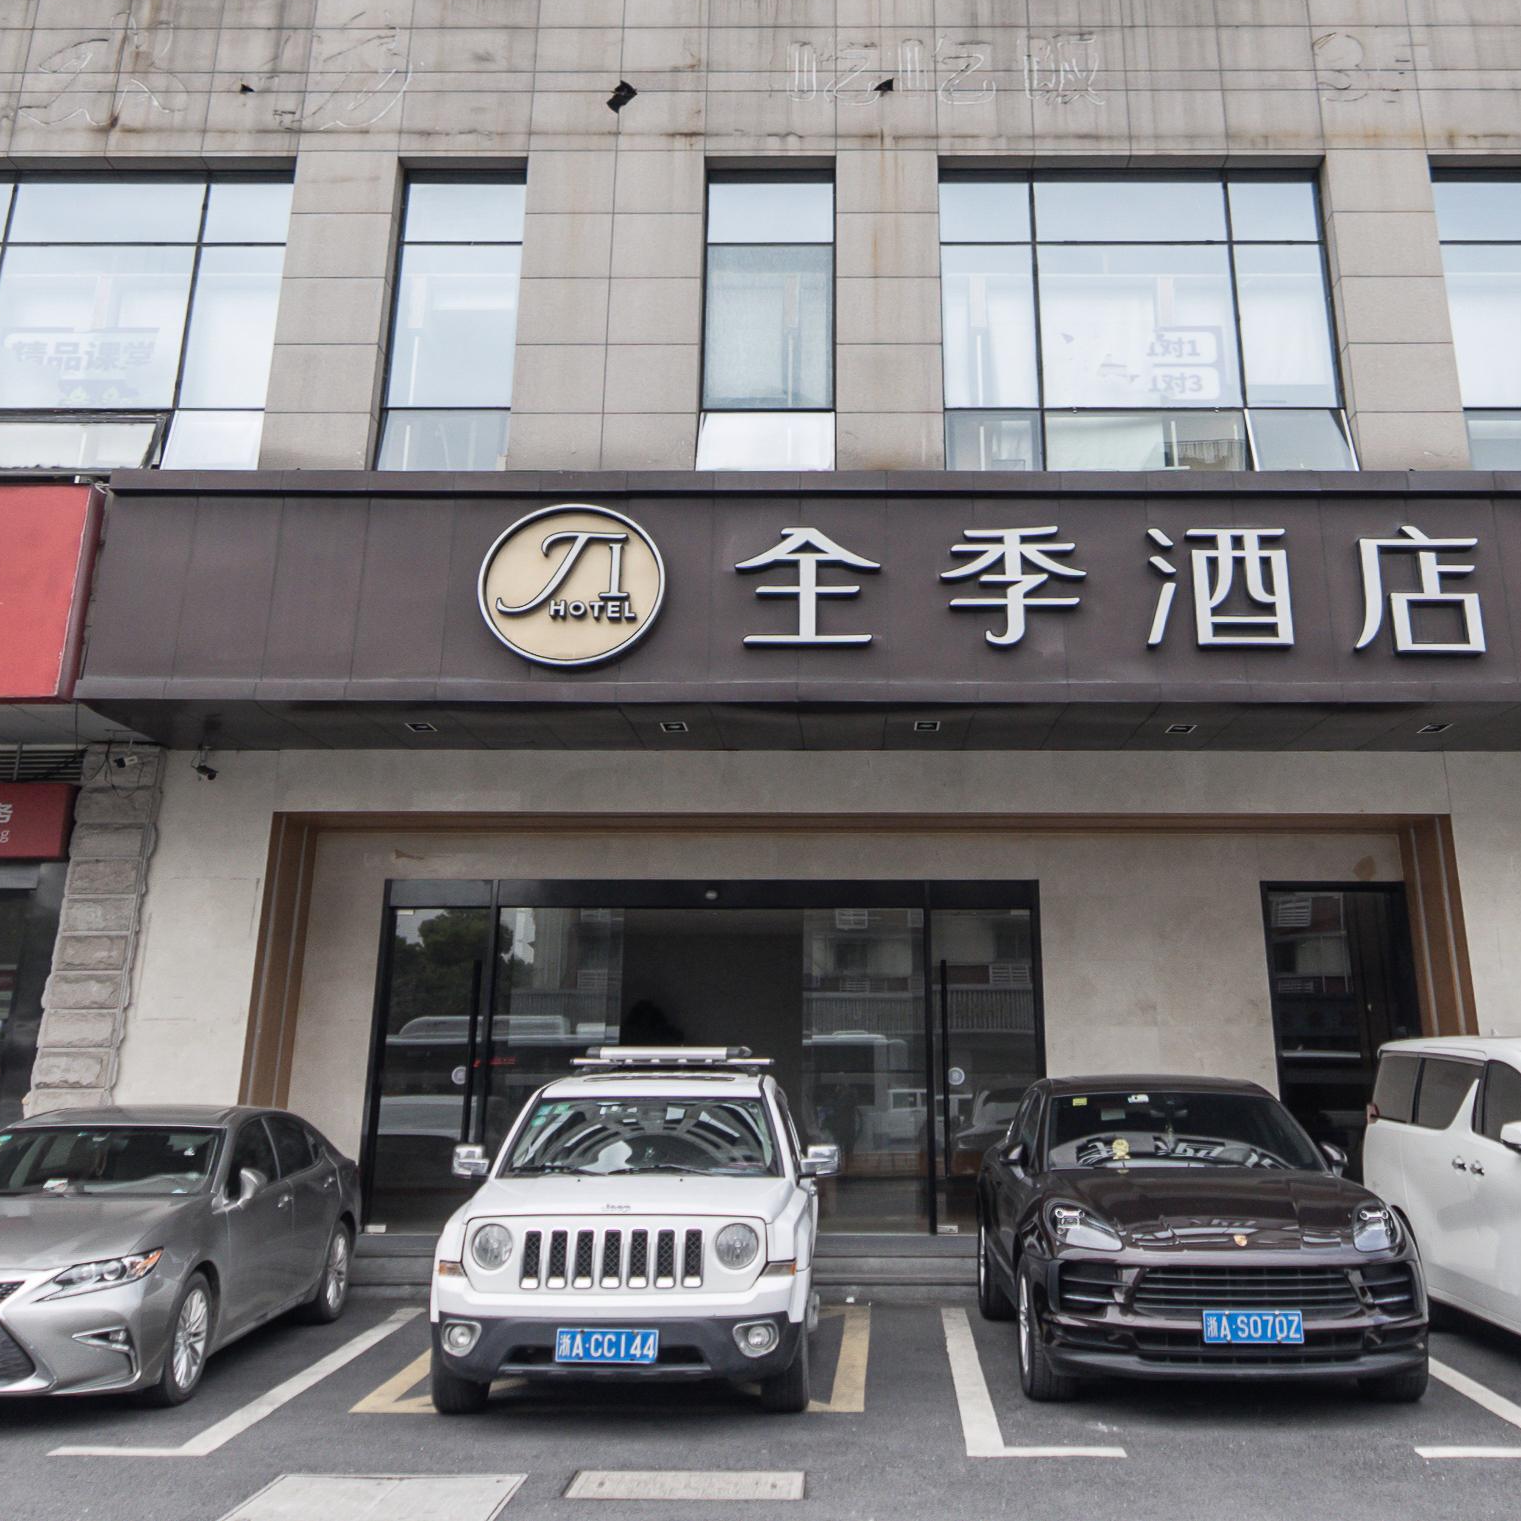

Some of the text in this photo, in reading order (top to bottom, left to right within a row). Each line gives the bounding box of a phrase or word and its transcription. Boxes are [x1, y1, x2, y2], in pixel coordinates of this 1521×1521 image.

[549, 597, 636, 621] HOTEL
[733, 524, 1488, 655] 全季酒店
